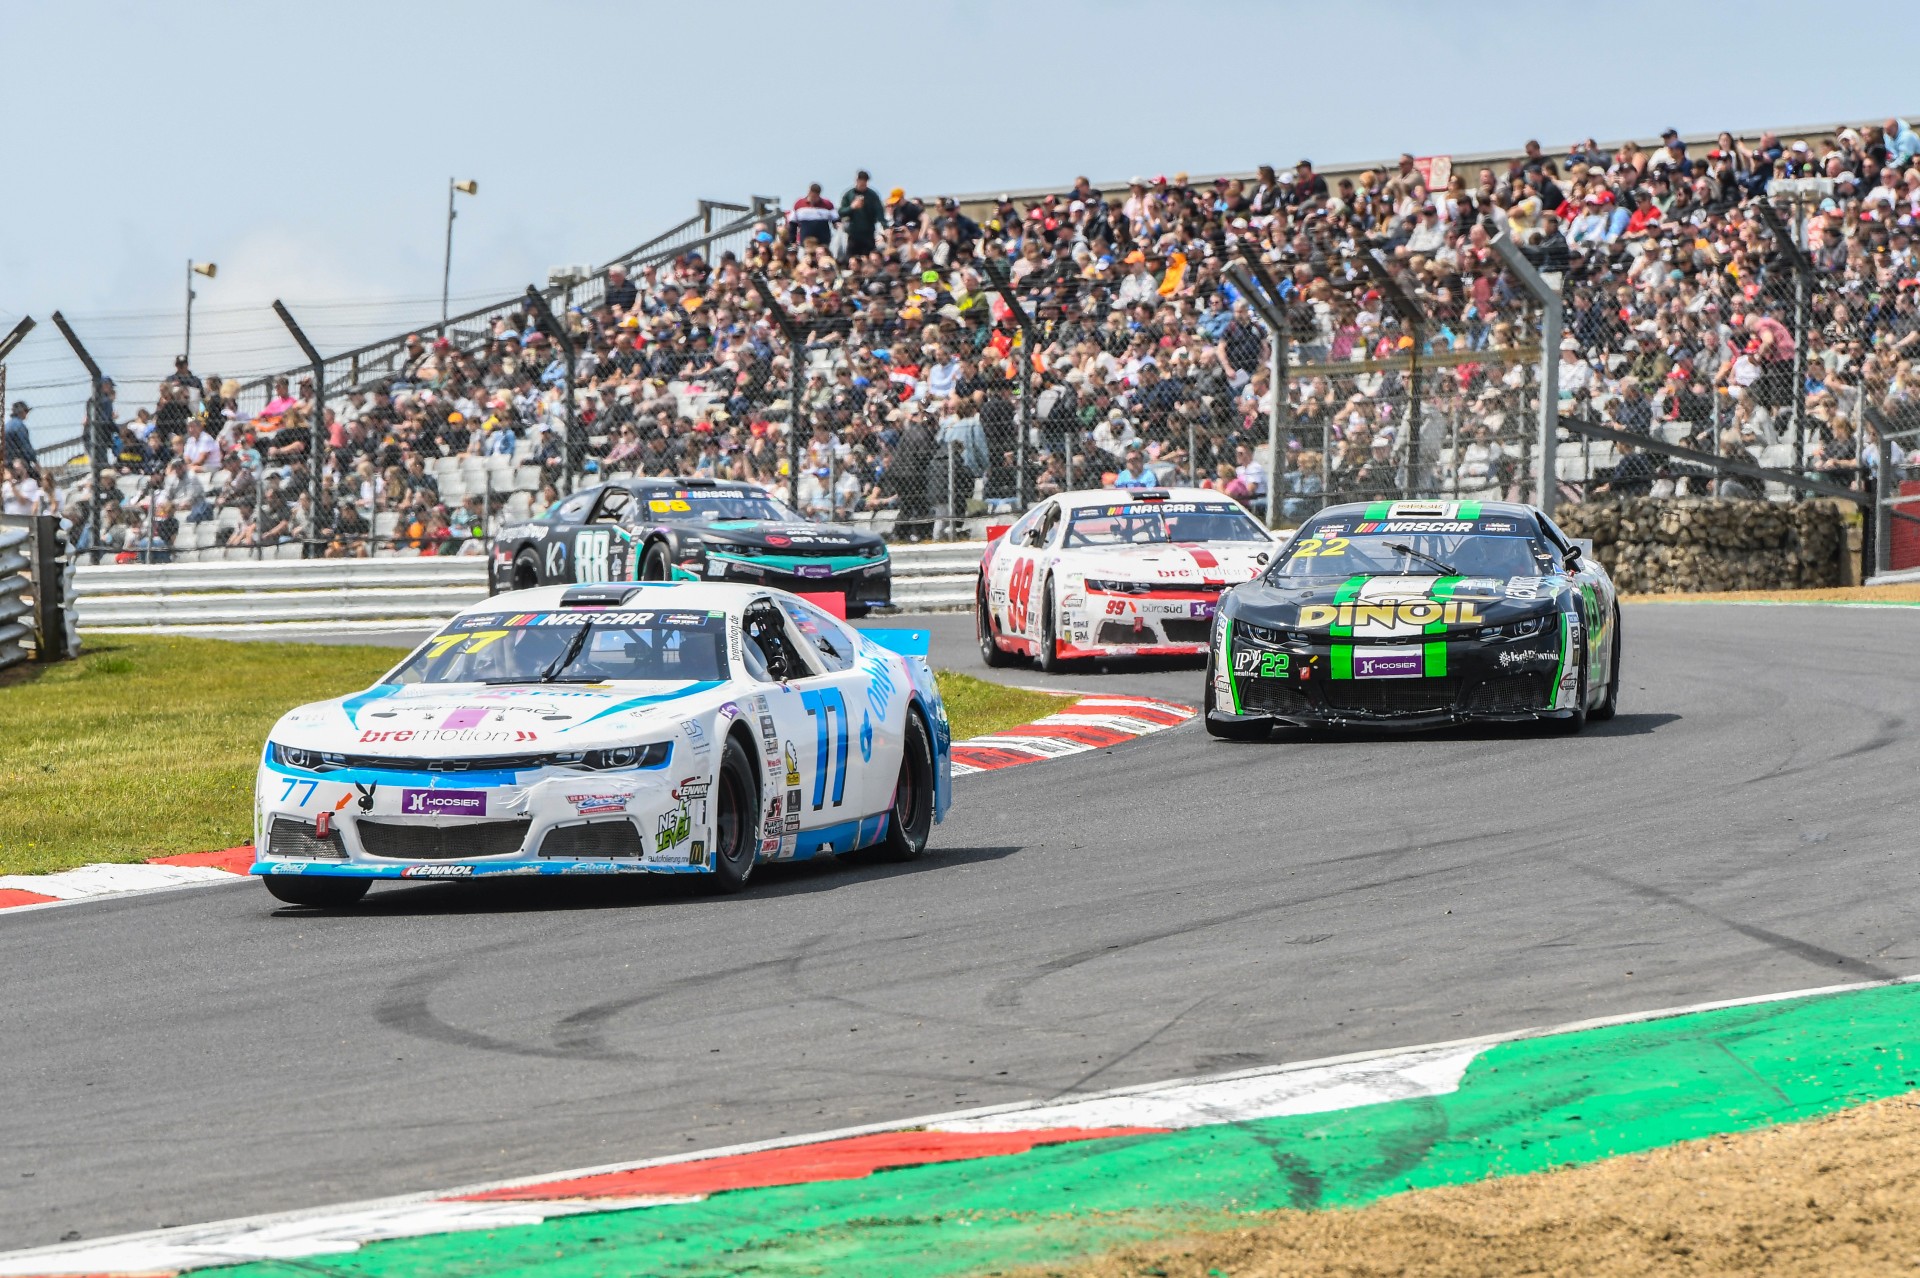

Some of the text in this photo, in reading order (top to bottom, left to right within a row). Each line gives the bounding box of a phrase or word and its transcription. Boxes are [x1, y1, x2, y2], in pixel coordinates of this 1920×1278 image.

[692, 490, 744, 499] NASCAR
[1129, 504, 1197, 514] NASCAR
[1385, 522, 1474, 533] NASCAR
[574, 530, 610, 583] 88
[1291, 537, 1351, 559] 22
[1157, 567, 1249, 579] bremotion
[1008, 557, 1034, 635] 99
[1105, 600, 1127, 616] 99
[1142, 601, 1184, 614] bürosüd
[1299, 599, 1485, 629] DINOIL
[539, 611, 655, 626] NASCAR
[427, 630, 510, 659] 77
[729, 614, 740, 662] bremotion.de
[1260, 651, 1291, 679] 22
[1375, 661, 1417, 670] HOOSIER
[359, 726, 510, 744] bremotion
[800, 686, 850, 812] 77
[280, 777, 320, 808] 77
[676, 784, 708, 797] KENNOL
[426, 797, 480, 808] HOOSIER
[657, 799, 692, 834] NEXT
[655, 817, 691, 853] LEVEL
[407, 864, 475, 876] KENNOL
